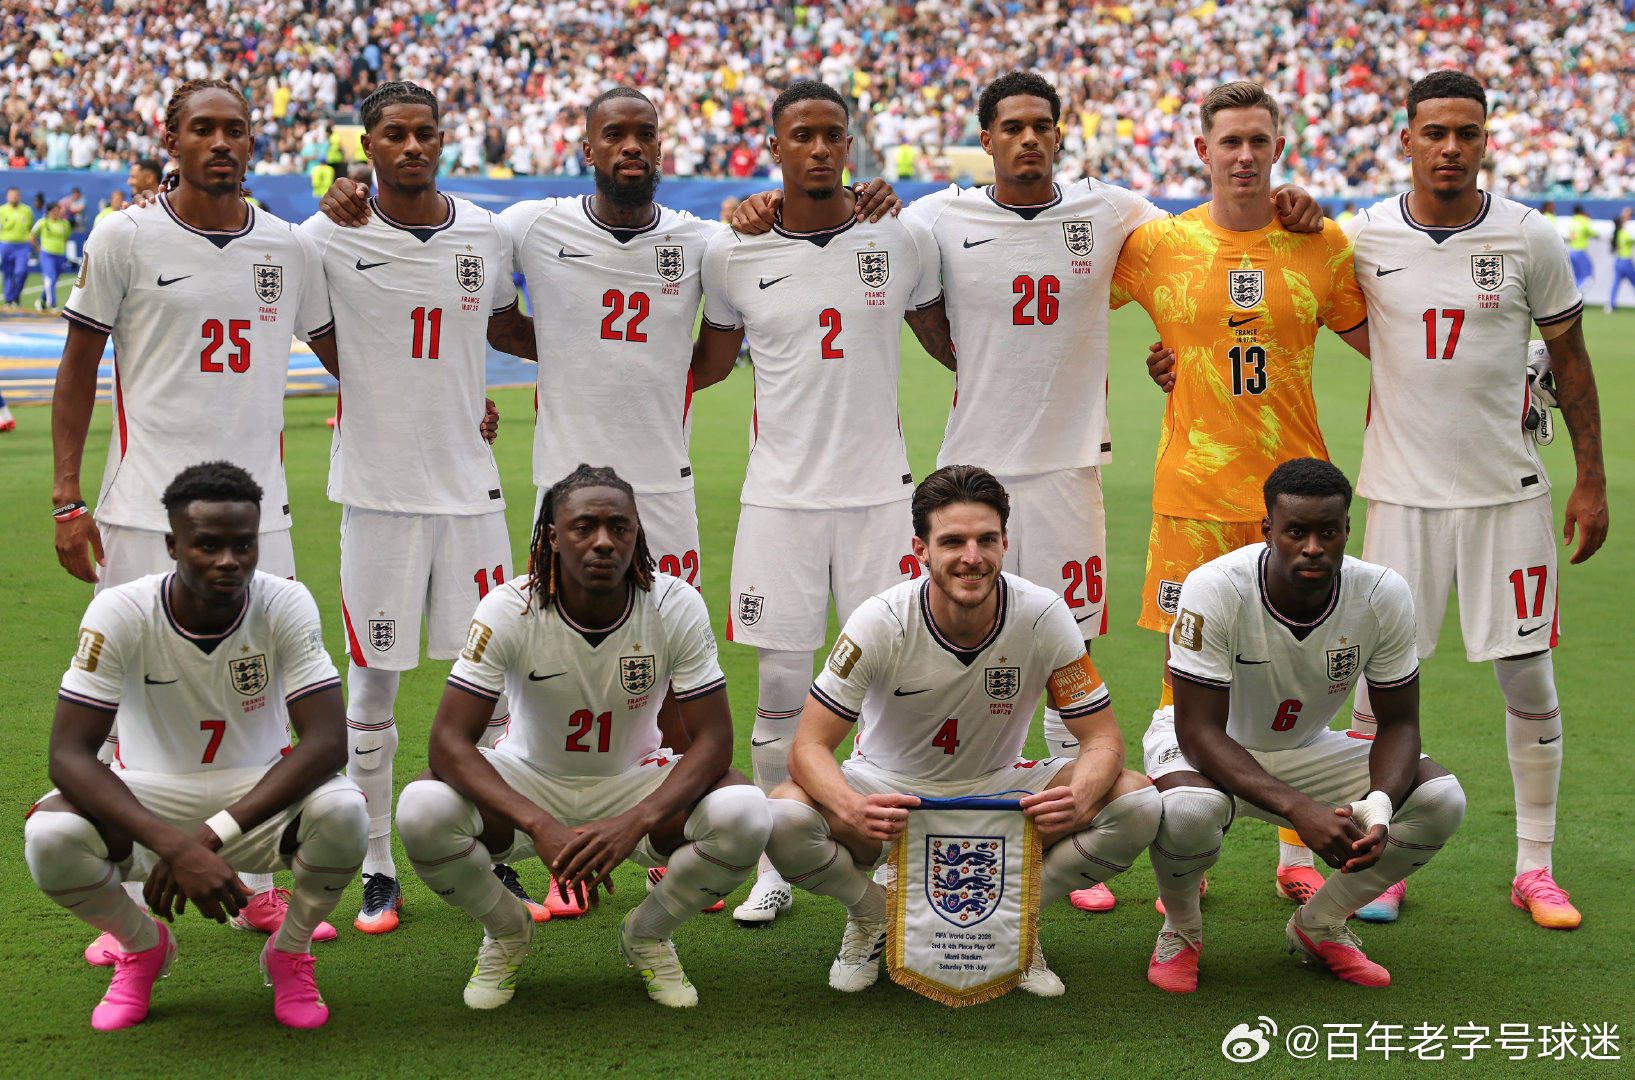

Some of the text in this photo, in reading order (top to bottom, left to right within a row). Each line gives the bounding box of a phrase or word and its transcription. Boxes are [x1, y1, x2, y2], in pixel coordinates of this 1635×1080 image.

[258, 306, 278, 315] FRANCE
[460, 296, 480, 304] FRANCE
[600, 288, 651, 343] 22
[1012, 275, 1061, 326] 26
[200, 319, 251, 373] 25
[411, 307, 442, 359] 11
[819, 307, 844, 359] 2
[1421, 308, 1466, 360] 17
[1227, 345, 1268, 396] 13
[1061, 555, 1104, 609] 26
[1508, 564, 1548, 620] 17
[1054, 668, 1088, 688] UNITES
[1070, 675, 1092, 693] World
[1071, 690, 1086, 700] FIFA
[627, 694, 649, 705] FRANCE
[1271, 699, 1303, 731] 6
[200, 720, 226, 764] 7
[565, 709, 612, 753] 21
[932, 718, 960, 755] 4
[965, 933, 976, 941] Cup
[974, 943, 986, 951] Play
[939, 963, 962, 971] Saturday
[944, 952, 960, 960] Miami
